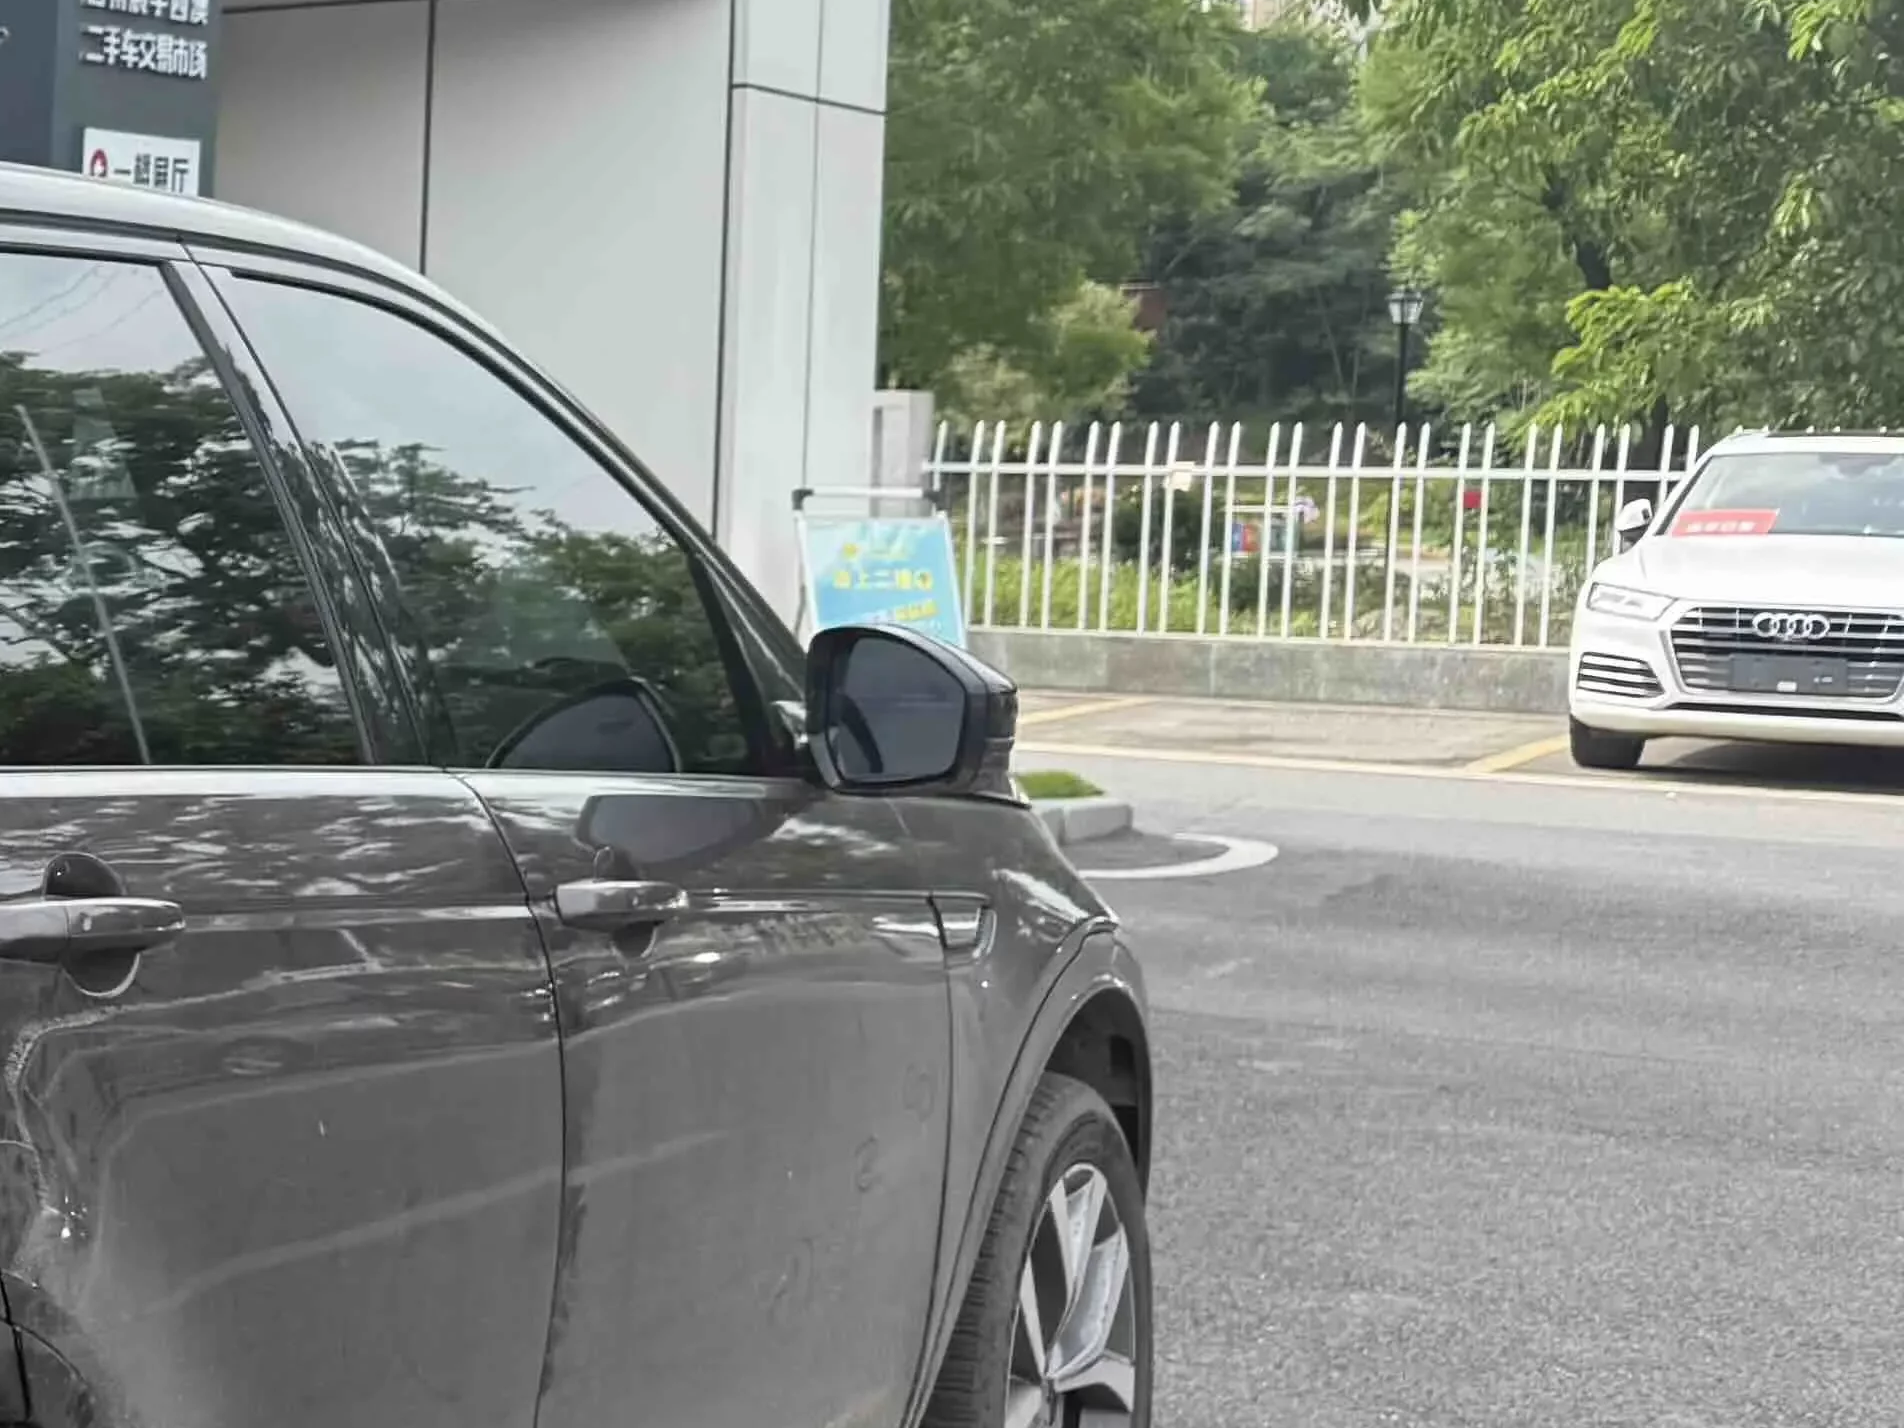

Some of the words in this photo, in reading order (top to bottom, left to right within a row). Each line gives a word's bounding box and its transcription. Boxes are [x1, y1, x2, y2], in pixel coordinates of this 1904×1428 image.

[86, 24, 208, 79] 二手车交易市场
